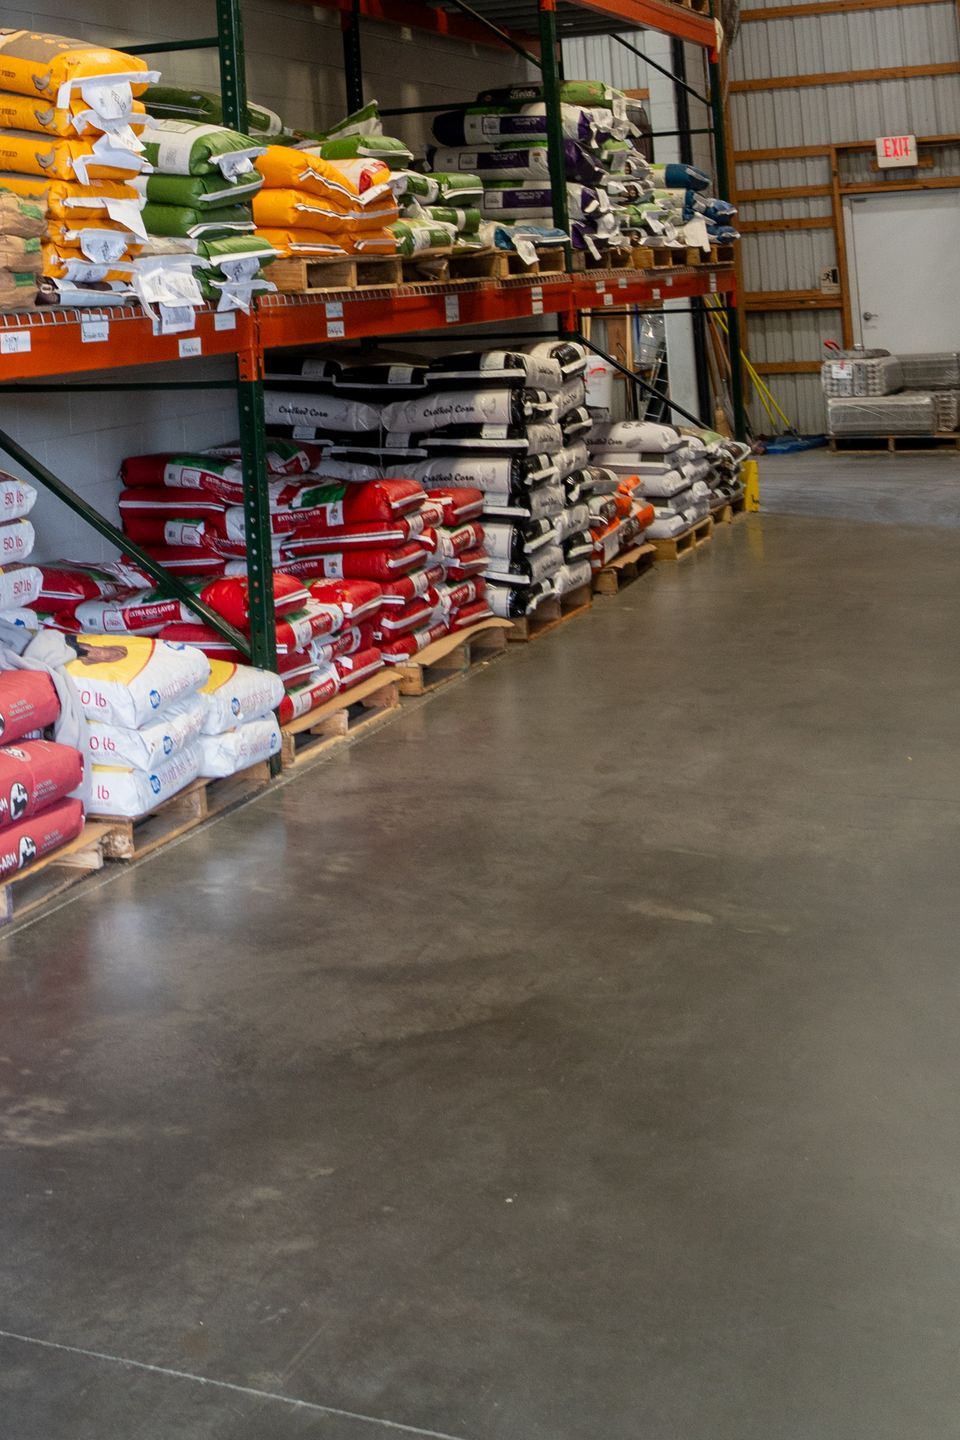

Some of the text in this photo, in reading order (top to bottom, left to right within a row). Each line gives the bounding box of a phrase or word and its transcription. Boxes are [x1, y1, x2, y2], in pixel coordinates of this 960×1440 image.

[1, 107, 17, 116] FEED
[2, 149, 18, 158] FEED
[883, 137, 909, 158] EXIT
[310, 408, 328, 418] Corn
[455, 404, 474, 414] Corn
[455, 473, 474, 482] Corn
[16, 491, 25, 503] lb
[3, 538, 14, 550] 50
[15, 536, 24, 549] lb
[23, 579, 32, 592] lb
[158, 604, 175, 613] LAYER
[95, 691, 107, 707] lb
[102, 737, 116, 752] lb
[97, 785, 110, 801] lb
